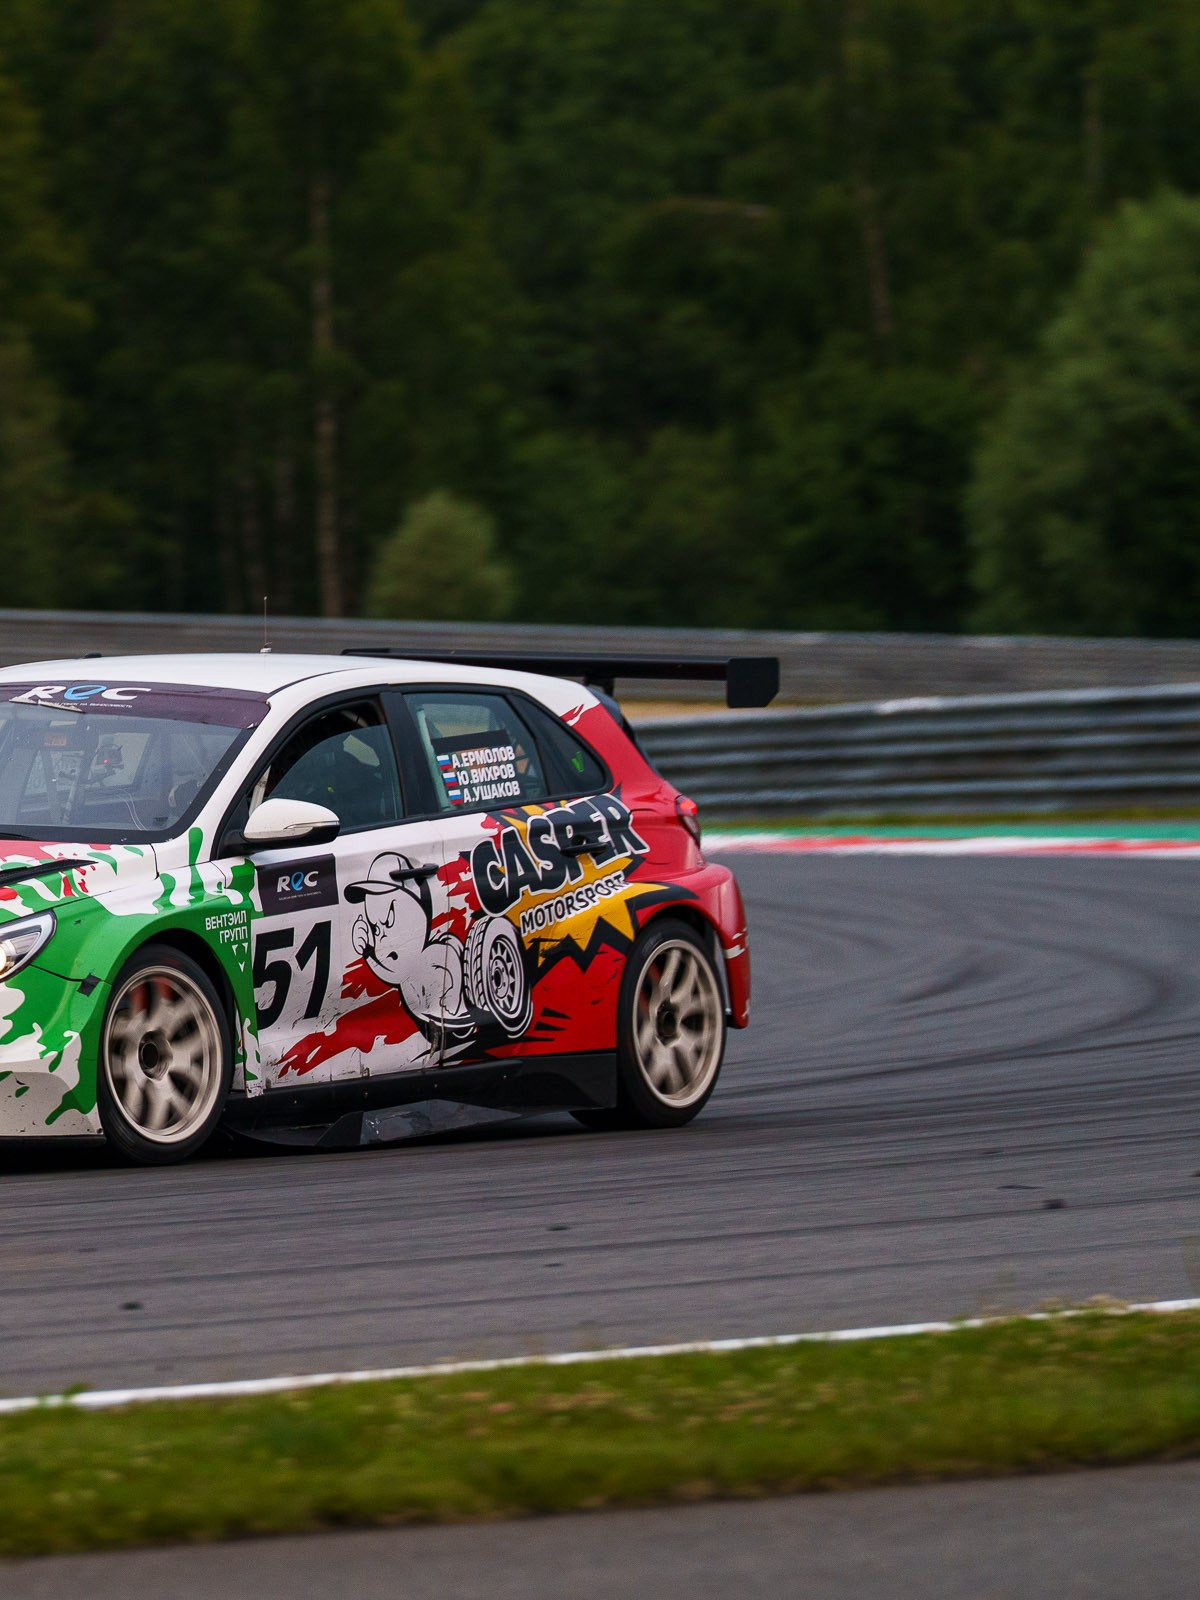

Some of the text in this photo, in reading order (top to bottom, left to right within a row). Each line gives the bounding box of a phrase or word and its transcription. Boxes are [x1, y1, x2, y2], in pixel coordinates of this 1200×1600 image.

[451, 745, 516, 769] А.ЕРМОЛОВ
[456, 763, 516, 786] Ю.ВИХРОВ
[463, 780, 521, 804] А.УШАКОВ
[470, 793, 650, 917] CASPER
[520, 872, 632, 935] MOTORSPORT
[205, 910, 247, 931] ВЕНТЭИЛ
[219, 926, 248, 944] ГРУПП
[253, 920, 332, 1030] 51
